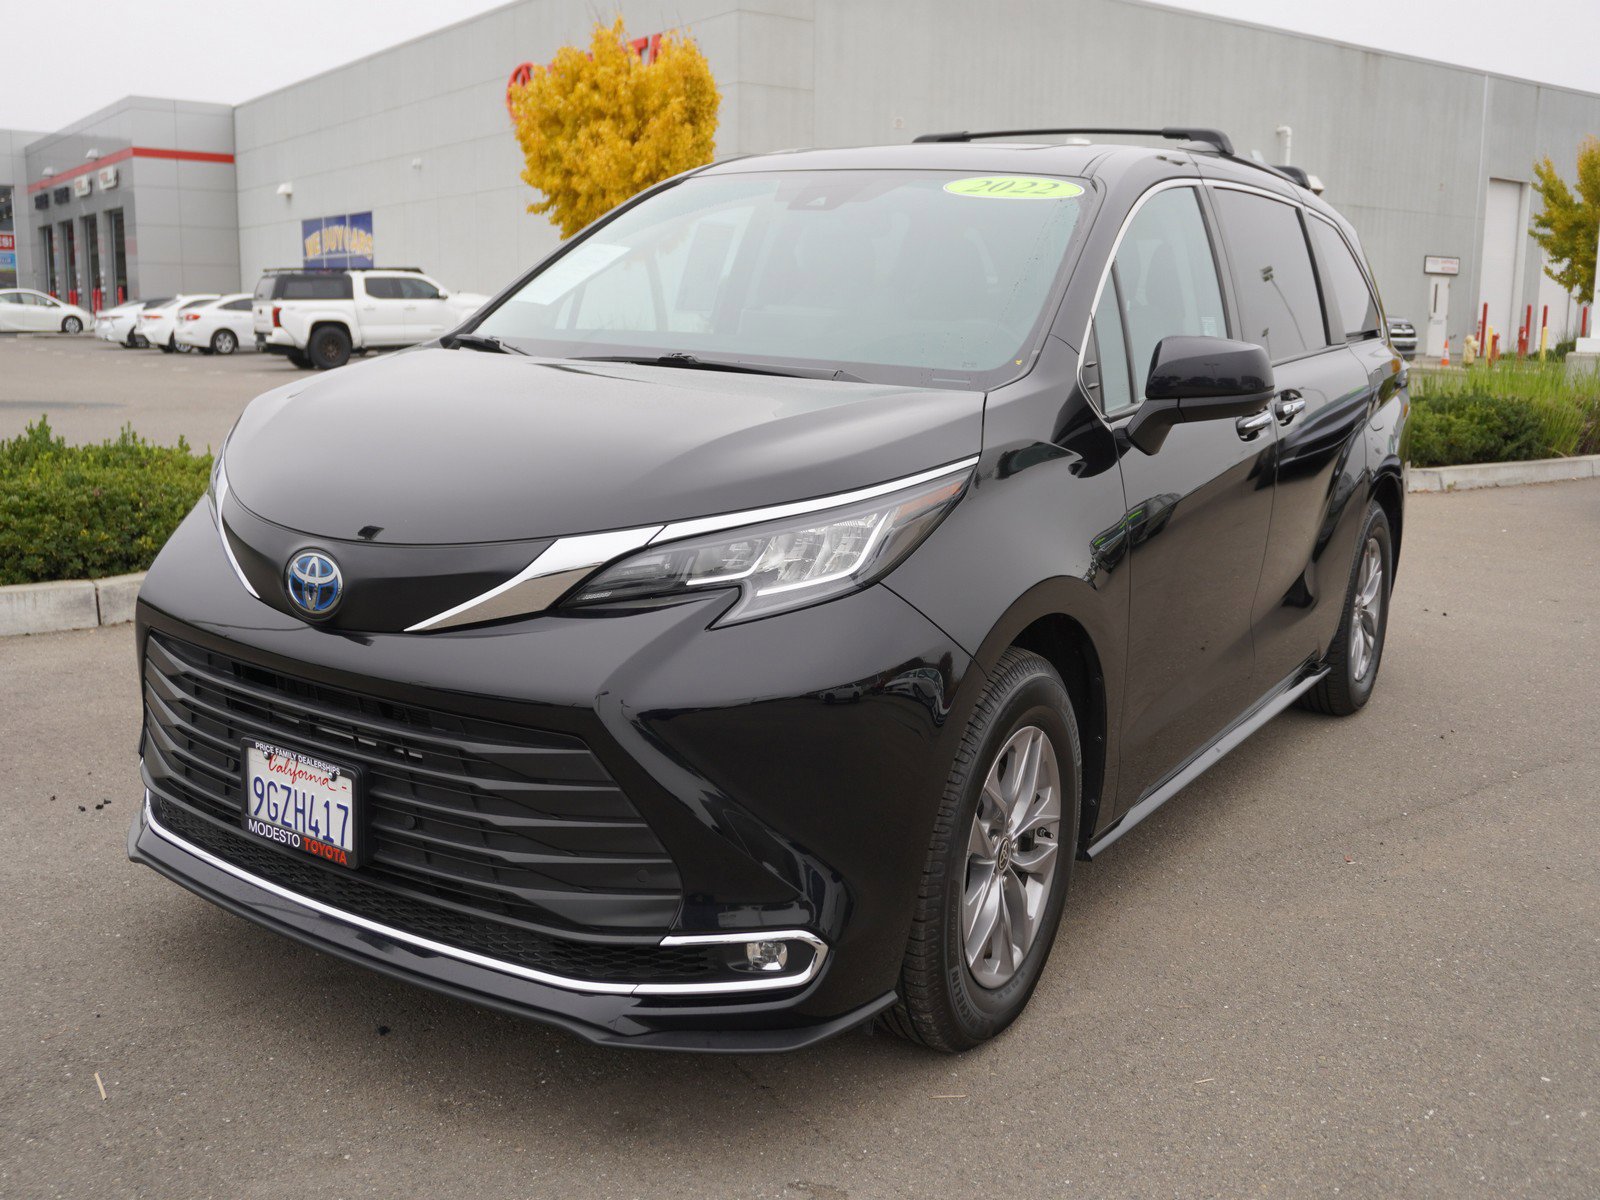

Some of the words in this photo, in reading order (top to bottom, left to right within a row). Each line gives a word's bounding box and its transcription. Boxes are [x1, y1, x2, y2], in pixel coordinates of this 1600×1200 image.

[963, 180, 1060, 194] 2022
[305, 230, 321, 259] WE
[344, 226, 373, 261] CARS
[255, 742, 274, 754] PRICE
[274, 747, 297, 760] FAMILY
[297, 755, 341, 776] DEALERSHIPS
[268, 753, 337, 792] California
[253, 776, 349, 848] 9GZH417
[248, 819, 301, 848] MODESTO
[303, 837, 348, 865] TOYOTA
